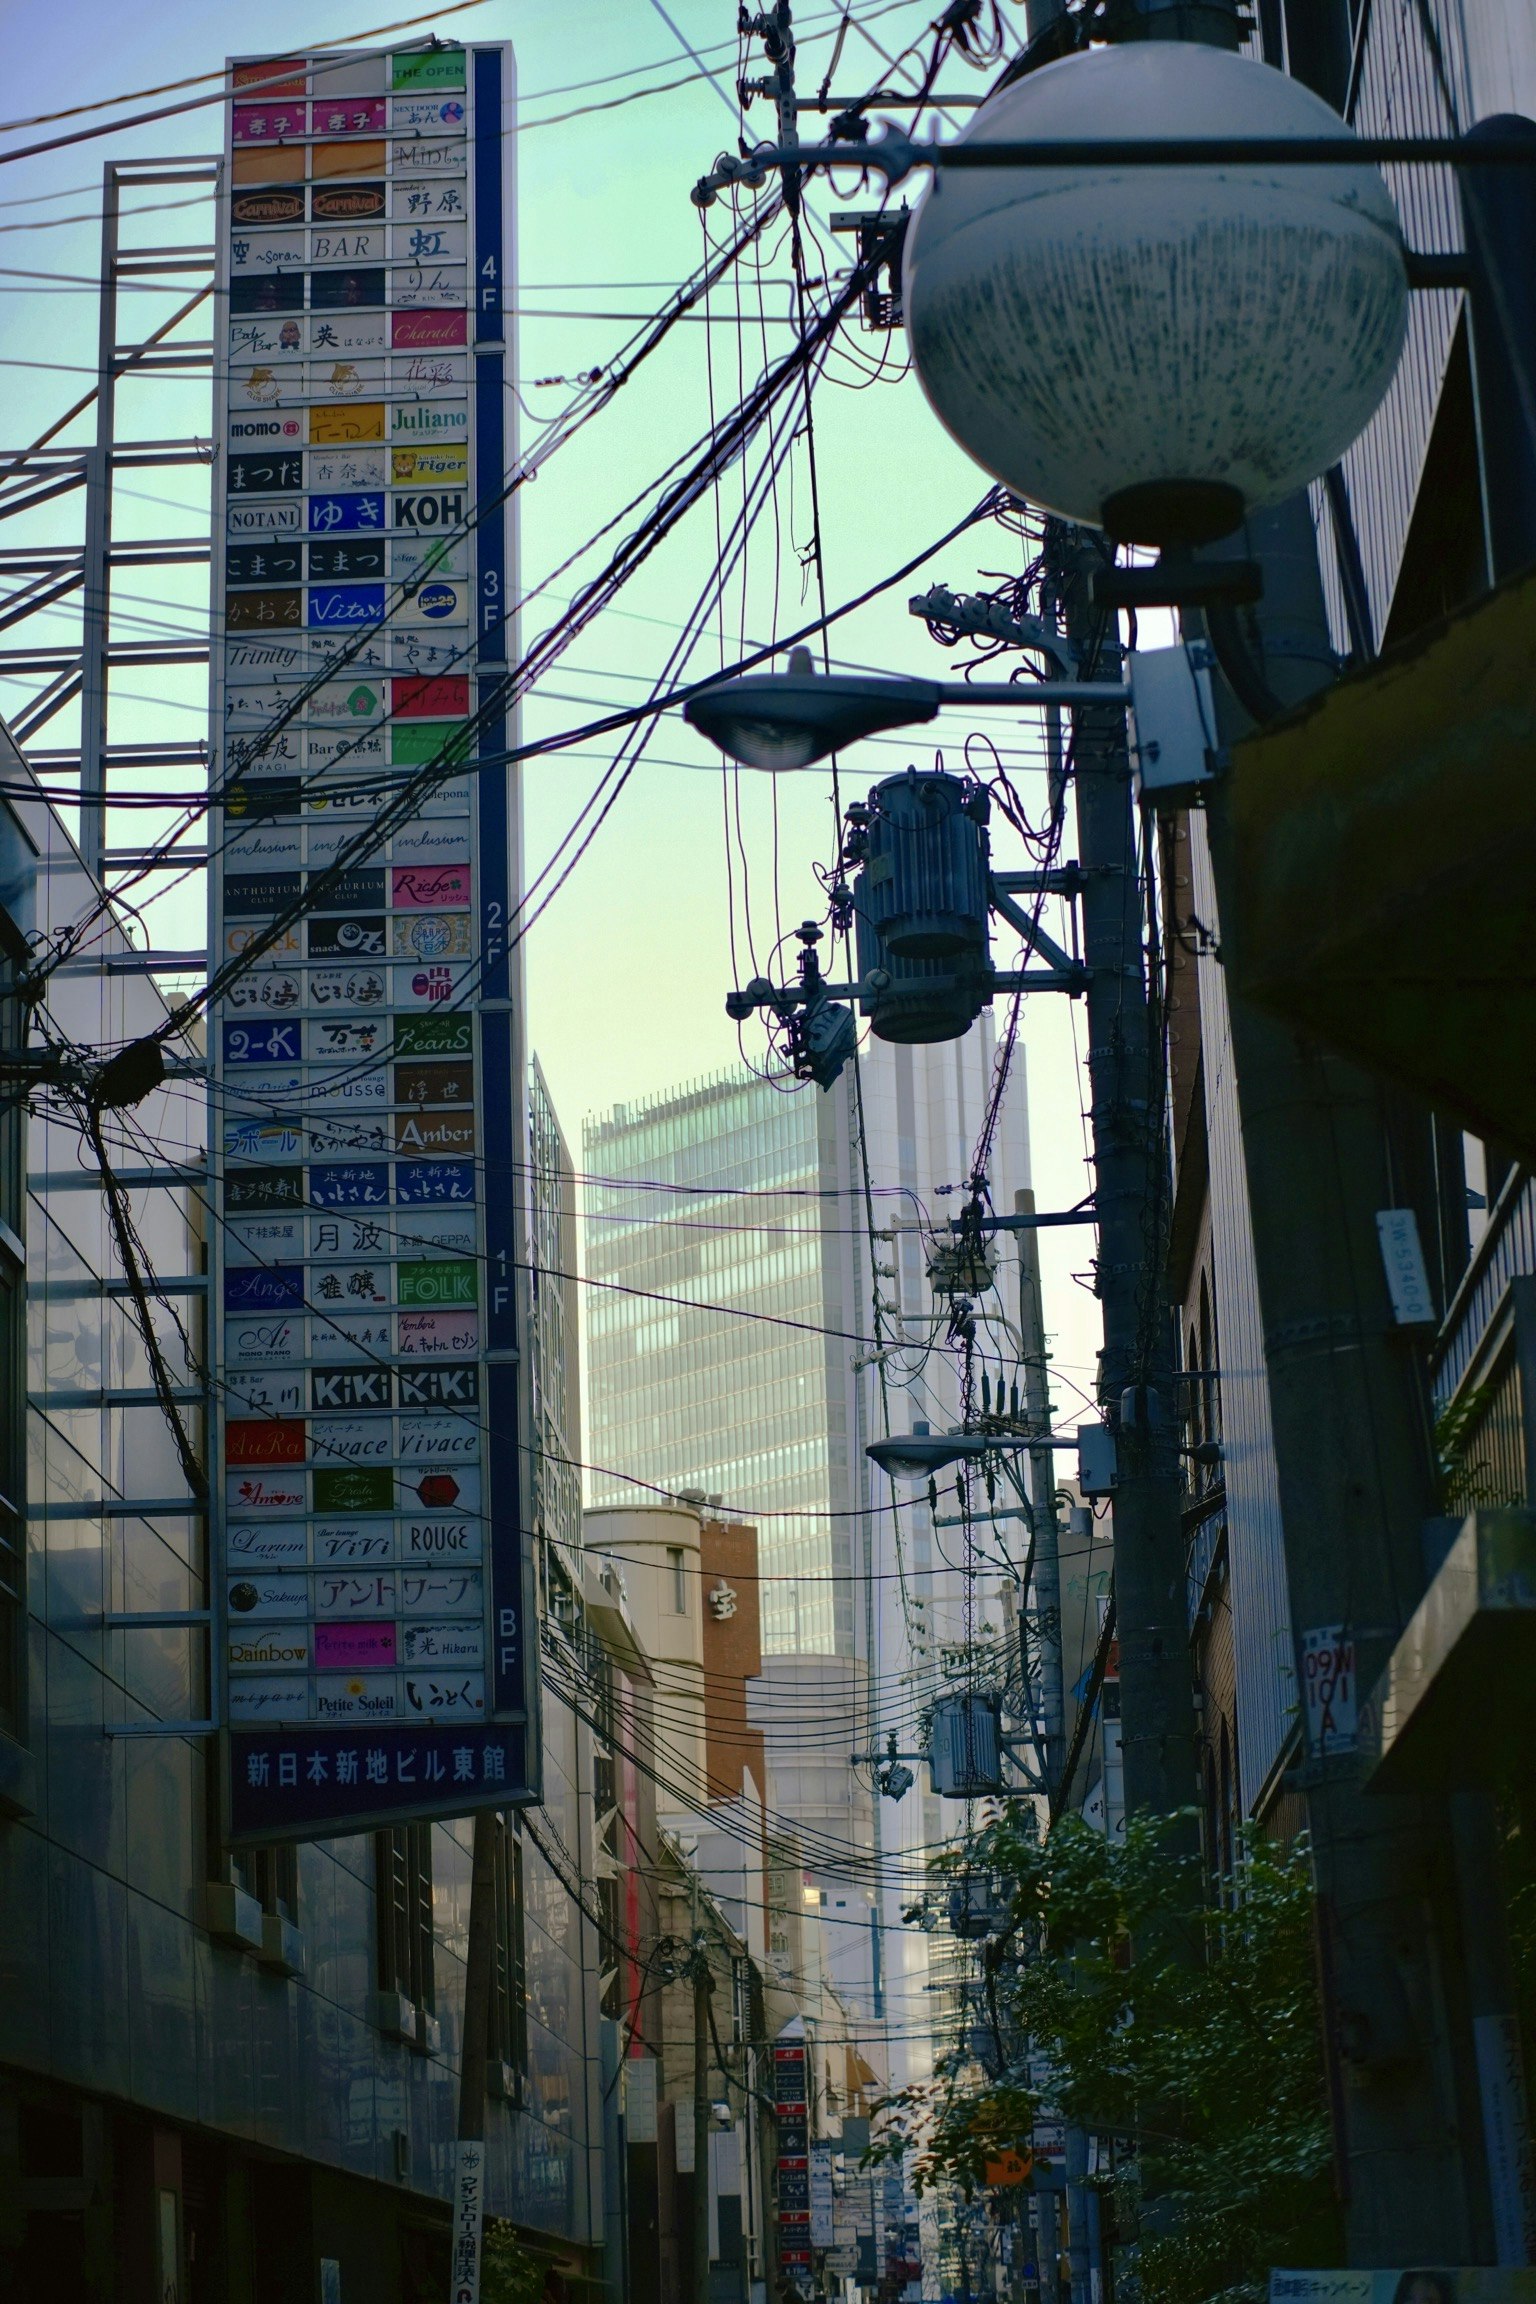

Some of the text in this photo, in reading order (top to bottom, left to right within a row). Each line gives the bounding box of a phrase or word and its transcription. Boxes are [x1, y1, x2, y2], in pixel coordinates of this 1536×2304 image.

[393, 66, 464, 79] THE OPEN
[416, 104, 439, 112] DOOR
[249, 117, 291, 135] 孝子
[328, 112, 375, 131] 孝子
[408, 113, 438, 125] あん
[234, 199, 301, 217] Carnival
[313, 195, 381, 214] Carnival
[408, 191, 462, 214] 野原
[232, 240, 250, 264] 空
[315, 236, 369, 258] BAR
[408, 229, 449, 257] 虹
[409, 270, 449, 292] りん
[313, 325, 340, 349] 英
[394, 315, 463, 341] Charade
[392, 407, 467, 431] Juliano
[232, 422, 281, 437] momo
[232, 460, 300, 489] まつだ
[317, 463, 357, 480] 杏奈
[416, 460, 466, 473] Tiger
[232, 512, 294, 527] NOTANI
[314, 498, 379, 531] ゆき
[395, 495, 462, 527] KOH
[228, 554, 296, 576] こまつ
[310, 551, 379, 571] こまつ
[228, 600, 300, 622] かおる
[229, 646, 298, 667] Trinity
[403, 645, 463, 664] やま本
[309, 743, 334, 754] Bar
[226, 838, 300, 856] inclusion
[394, 831, 467, 848] inclusion
[225, 885, 300, 896] ANTHURIUM
[228, 1026, 296, 1060] 2-K
[407, 1080, 460, 1100] 浮世
[224, 1130, 297, 1154] ラポール
[396, 1118, 473, 1151] Amber
[324, 1170, 375, 1182] 北新地
[409, 1166, 462, 1179] 北新地
[243, 1225, 295, 1239] 下桂茶屋
[314, 1221, 383, 1252] 月波
[431, 1234, 471, 1245] GEPPA
[229, 1274, 298, 1304] Ange
[400, 1276, 474, 1301] FOLK
[399, 1316, 436, 1331] Member's
[238, 1319, 289, 1349] Ai
[419, 1337, 449, 1351] キャトル
[452, 1332, 478, 1350] セゾン
[238, 1351, 262, 1360] NONO
[265, 1350, 291, 1359] PIANO
[250, 1376, 264, 1384] Bar
[315, 1373, 388, 1406] KiKi
[401, 1370, 474, 1402] KiKi
[249, 1386, 299, 1411] 江川
[228, 1431, 300, 1456] AuRa
[312, 1436, 388, 1457] Vivace
[401, 1434, 477, 1454] Vivace
[228, 1529, 304, 1553] Larum
[317, 1529, 336, 1538] Bar
[411, 1526, 468, 1550] ROUGE
[325, 1537, 390, 1558] ViVi
[259, 1590, 308, 1606] Sakuya
[229, 1644, 306, 1663] Rainbow
[420, 1636, 479, 1656] 光 Hikaru
[318, 1694, 394, 1712] Petite Soleil
[406, 1680, 475, 1711] いっとく
[247, 1745, 505, 1788] 新日本新地ビル東館
